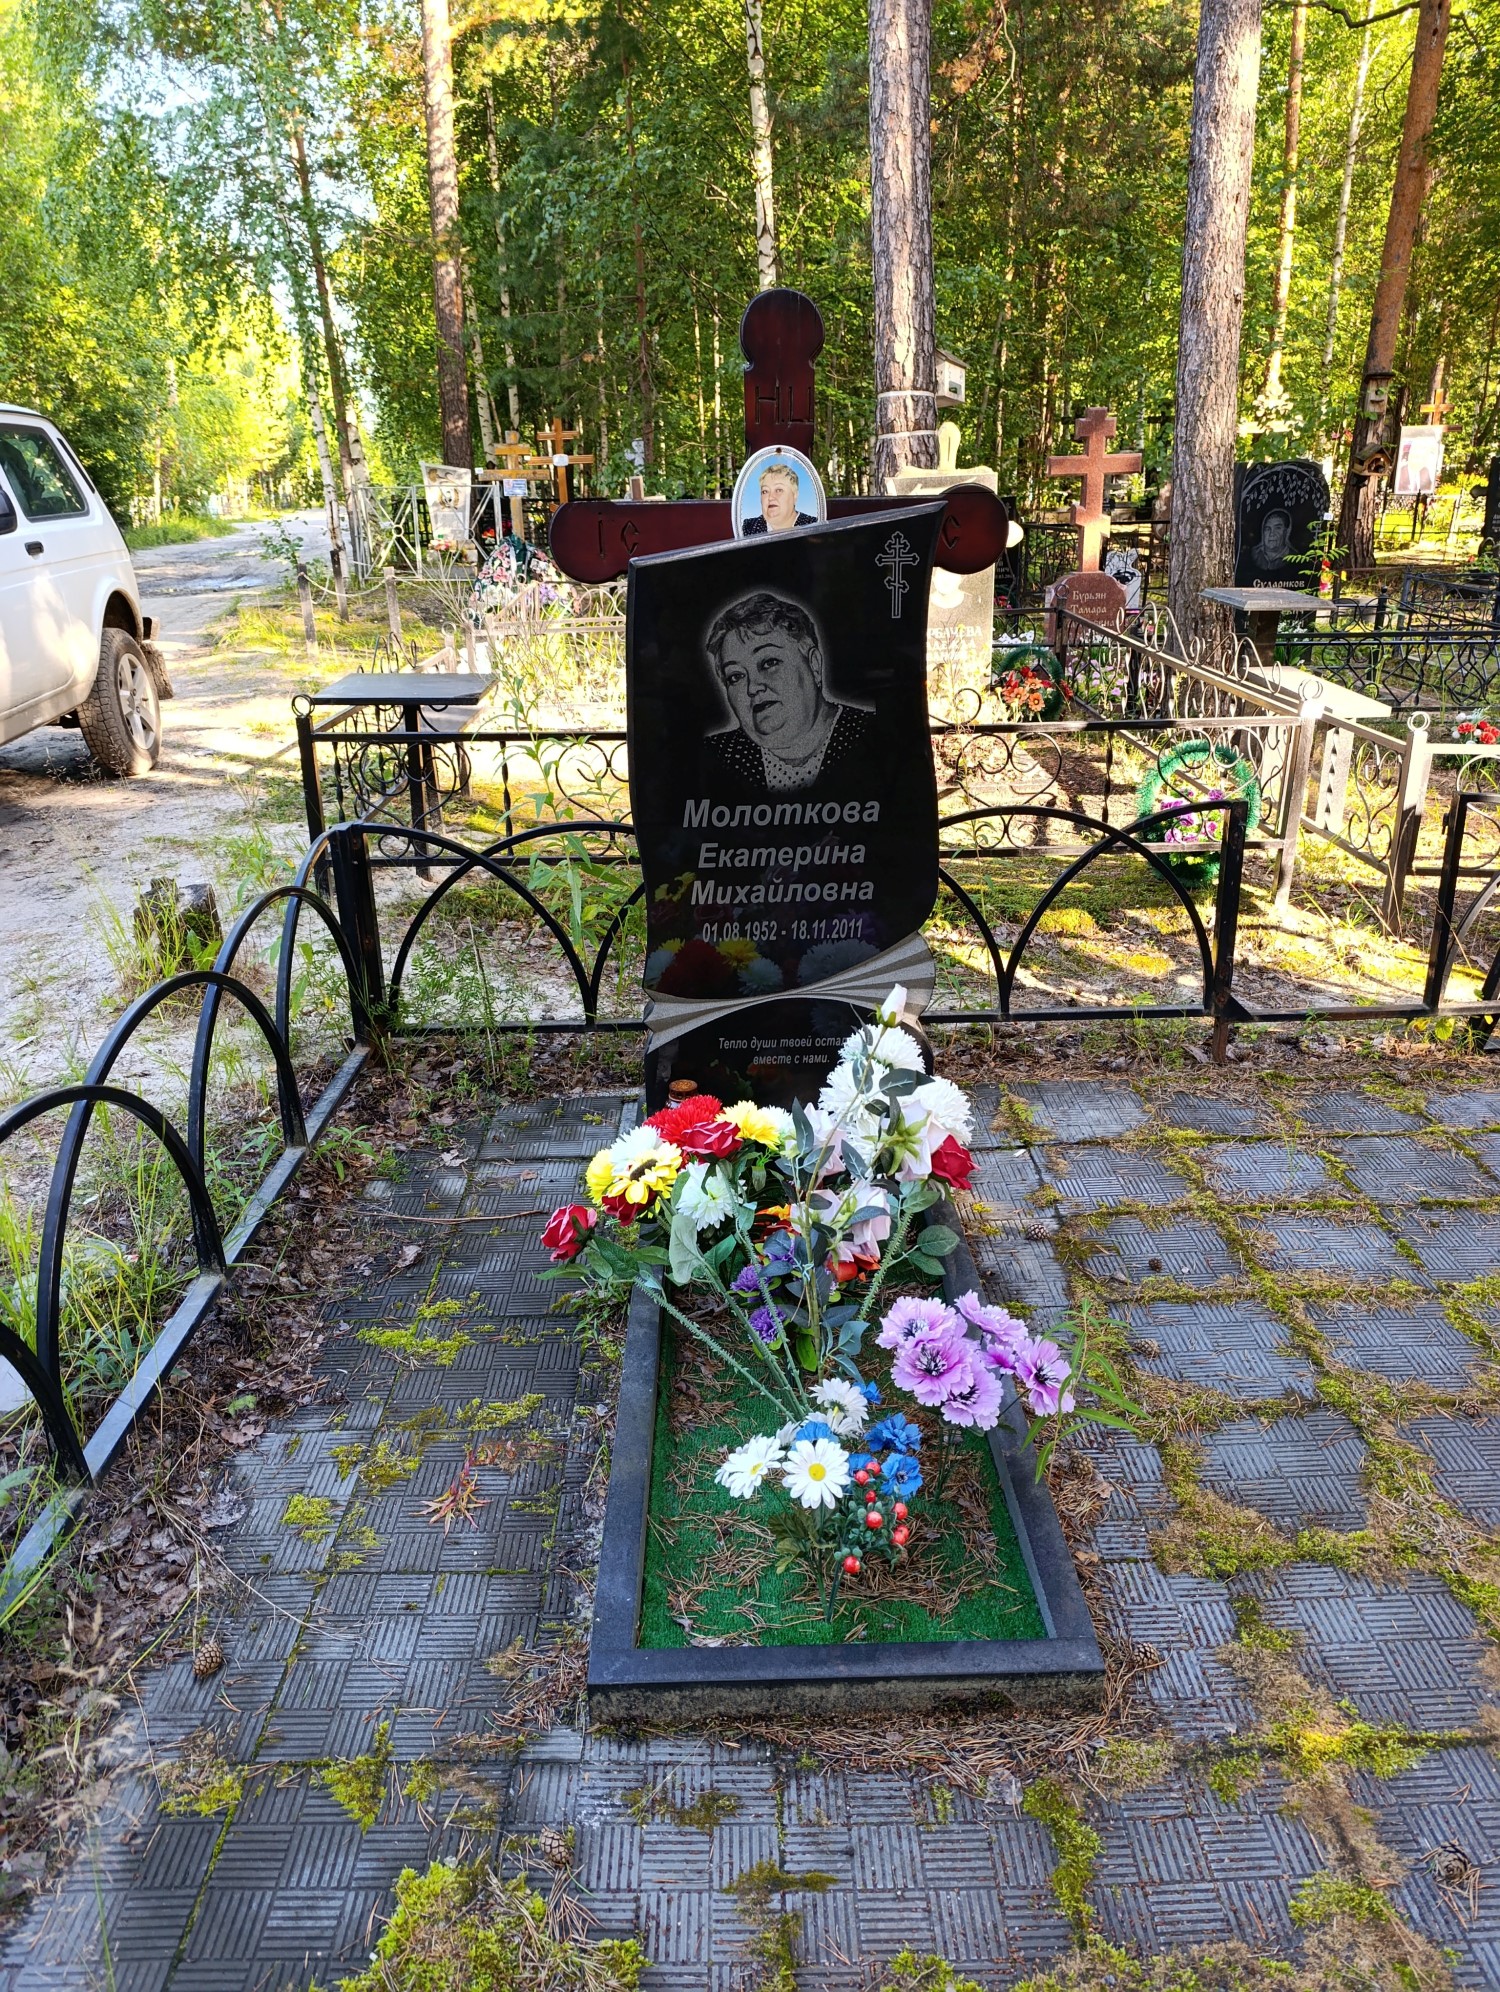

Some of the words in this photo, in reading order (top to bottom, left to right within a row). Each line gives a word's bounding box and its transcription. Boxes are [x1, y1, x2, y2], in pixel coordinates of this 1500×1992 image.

[1072, 590, 1107, 603] Бурьян
[1070, 604, 1107, 615] Тамара
[683, 798, 881, 828] Молоткова
[698, 842, 866, 872] Екатерина
[690, 877, 875, 905] Михайловна
[702, 920, 778, 943] 01.08.1952
[791, 918, 863, 940] 18.11.2011
[718, 1037, 748, 1050] Тепло
[750, 1036, 778, 1052] души
[780, 1035, 812, 1048] твоей
[753, 1055, 792, 1066] вместе
[794, 1054, 800, 1064] с
[802, 1053, 831, 1064] нами.
